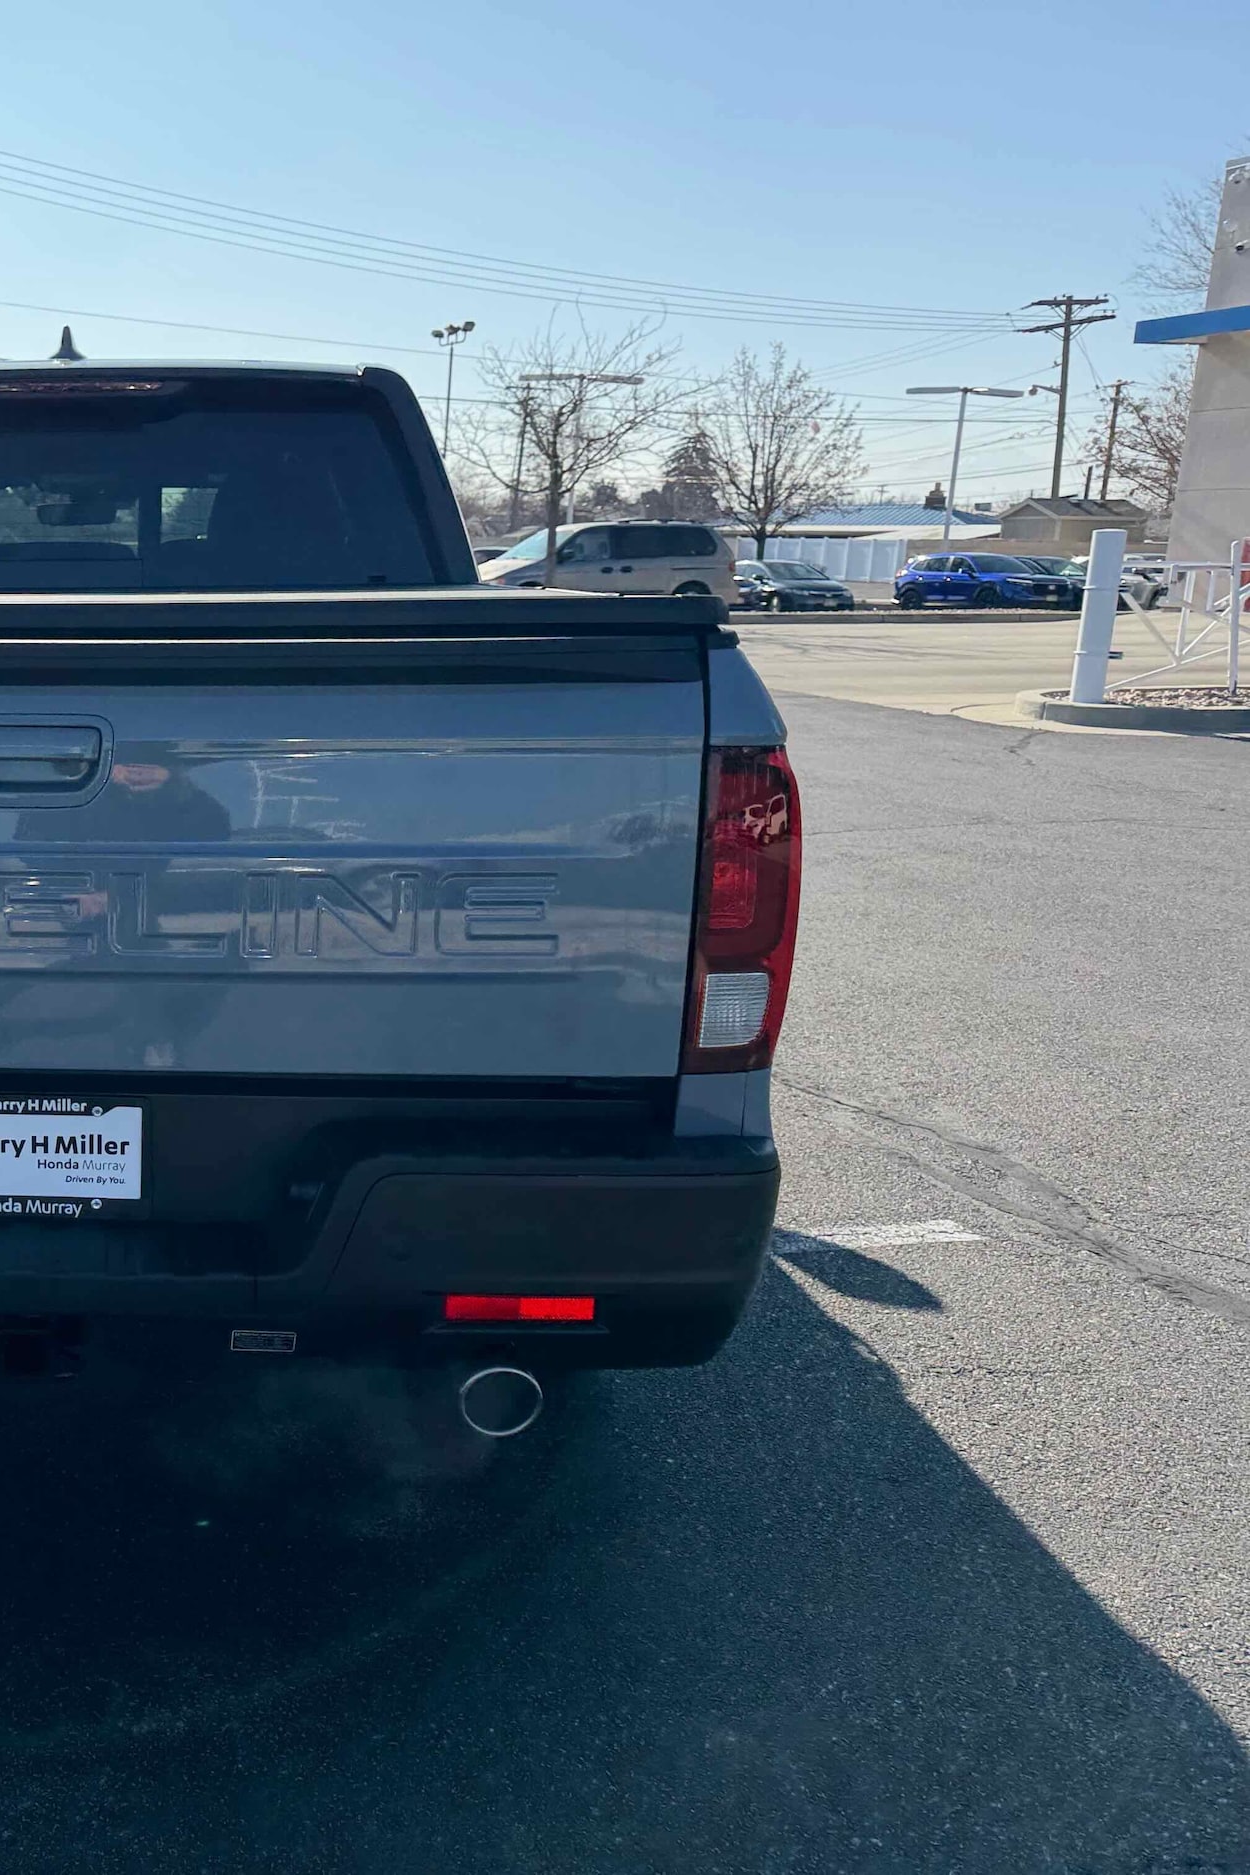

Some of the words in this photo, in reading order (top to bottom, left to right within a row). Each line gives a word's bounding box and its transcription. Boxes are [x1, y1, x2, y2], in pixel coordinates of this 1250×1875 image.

[27, 1099, 40, 1111] H
[41, 1098, 88, 1113] Miller
[31, 1135, 49, 1154] H
[54, 1134, 131, 1156] Miller
[37, 1158, 79, 1170] Honda
[82, 1159, 127, 1173] Murray
[65, 1175, 94, 1184] Driven
[96, 1176, 108, 1186] By
[25, 1199, 83, 1218] Murray
